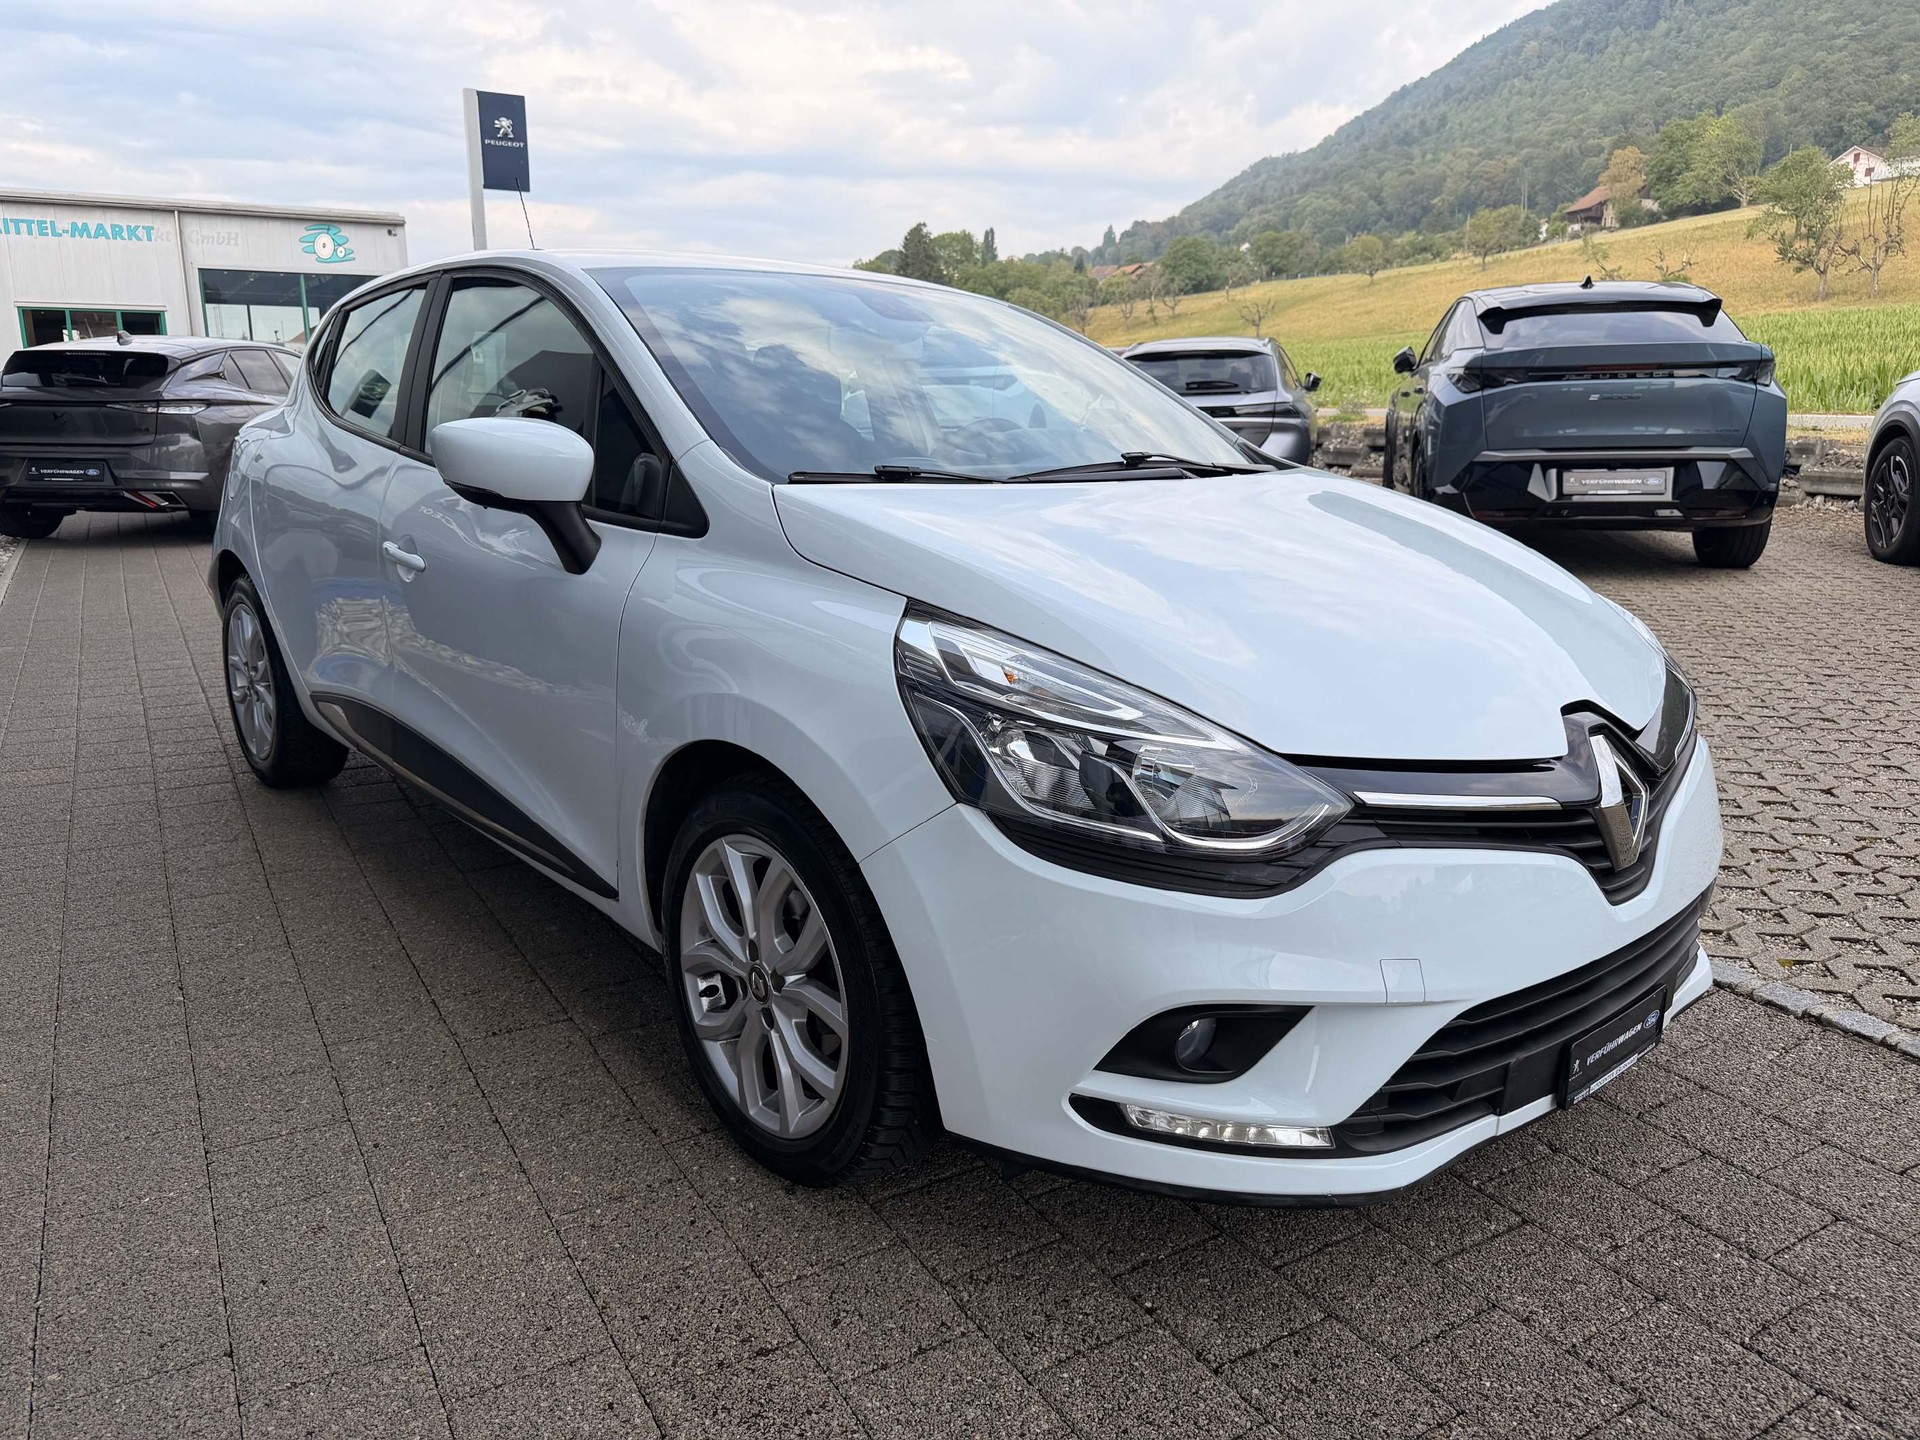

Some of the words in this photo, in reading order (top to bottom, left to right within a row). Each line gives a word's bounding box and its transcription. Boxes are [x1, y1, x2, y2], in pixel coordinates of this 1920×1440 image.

[484, 139, 525, 148] PEUGEOT
[0, 217, 154, 242] ITTEL-MARKT
[1586, 1022, 1643, 1066] VERFÜHRWAGEN
